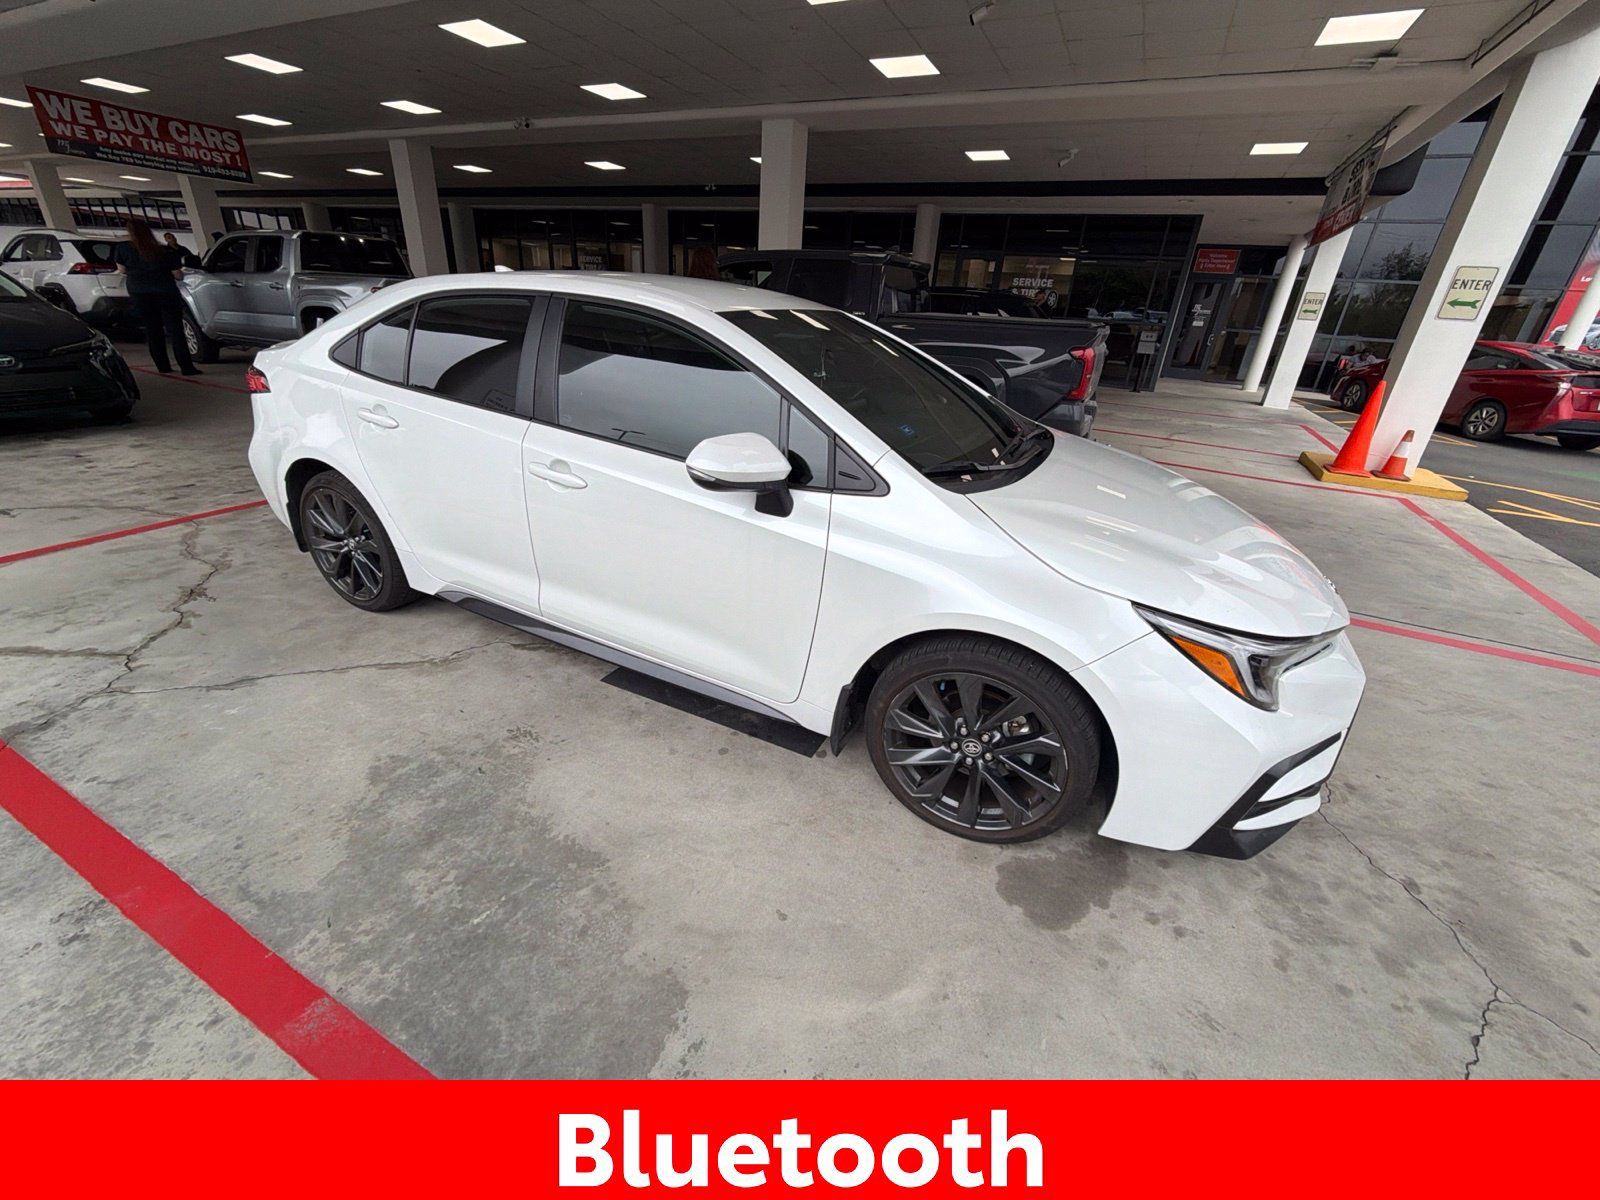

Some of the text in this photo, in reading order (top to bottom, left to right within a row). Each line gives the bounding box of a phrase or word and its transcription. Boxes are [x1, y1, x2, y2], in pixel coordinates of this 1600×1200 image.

[37, 92, 240, 153] WE BUY CARS
[50, 119, 90, 141] WE
[93, 130, 135, 148] PAY
[139, 137, 178, 156] THE
[181, 144, 234, 165] MOST
[1012, 277, 1054, 287] SERVICE
[1451, 278, 1492, 290] ENTER
